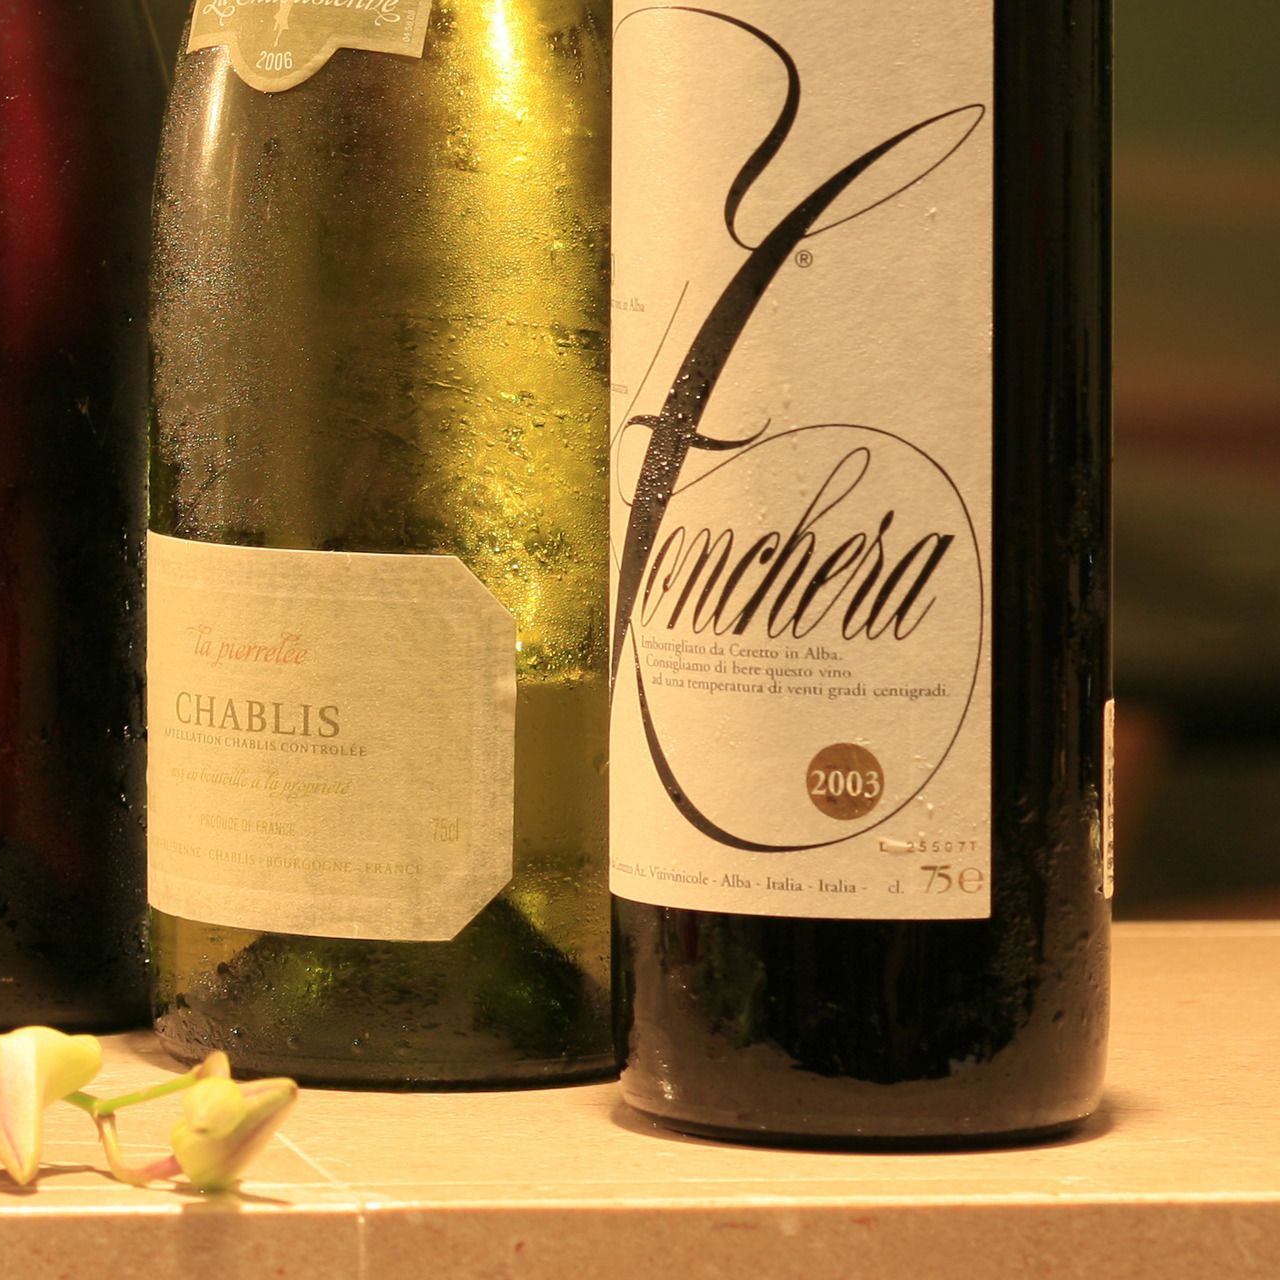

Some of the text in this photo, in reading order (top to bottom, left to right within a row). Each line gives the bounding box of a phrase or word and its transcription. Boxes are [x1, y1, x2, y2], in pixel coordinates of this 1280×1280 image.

[256, 51, 293, 70] 2006
[710, 642, 725, 656] da
[729, 643, 779, 660] Ceretto
[785, 646, 799, 660] in
[804, 646, 844, 661] Alba.
[646, 655, 852, 681] Consigliamo di bere questo vino
[651, 675, 662, 687] ad
[665, 679, 685, 688] una
[687, 678, 765, 696] temperatura
[768, 680, 782, 695] di
[787, 683, 824, 696] venti
[828, 684, 867, 701] gradi
[176, 691, 341, 738] CHABLIS
[224, 737, 276, 752] CHABLIS
[810, 769, 881, 798] 2003
[200, 813, 296, 837] PRODUCE OF FRANCE
[429, 816, 460, 843] 75cl
[208, 848, 256, 866] CHABLIS
[266, 856, 353, 874] BOURGOGNE
[364, 863, 423, 876] FRANCE
[720, 873, 752, 889] Alba
[766, 877, 803, 893] Italia
[819, 879, 857, 894] Italia
[888, 879, 905, 894] cl.
